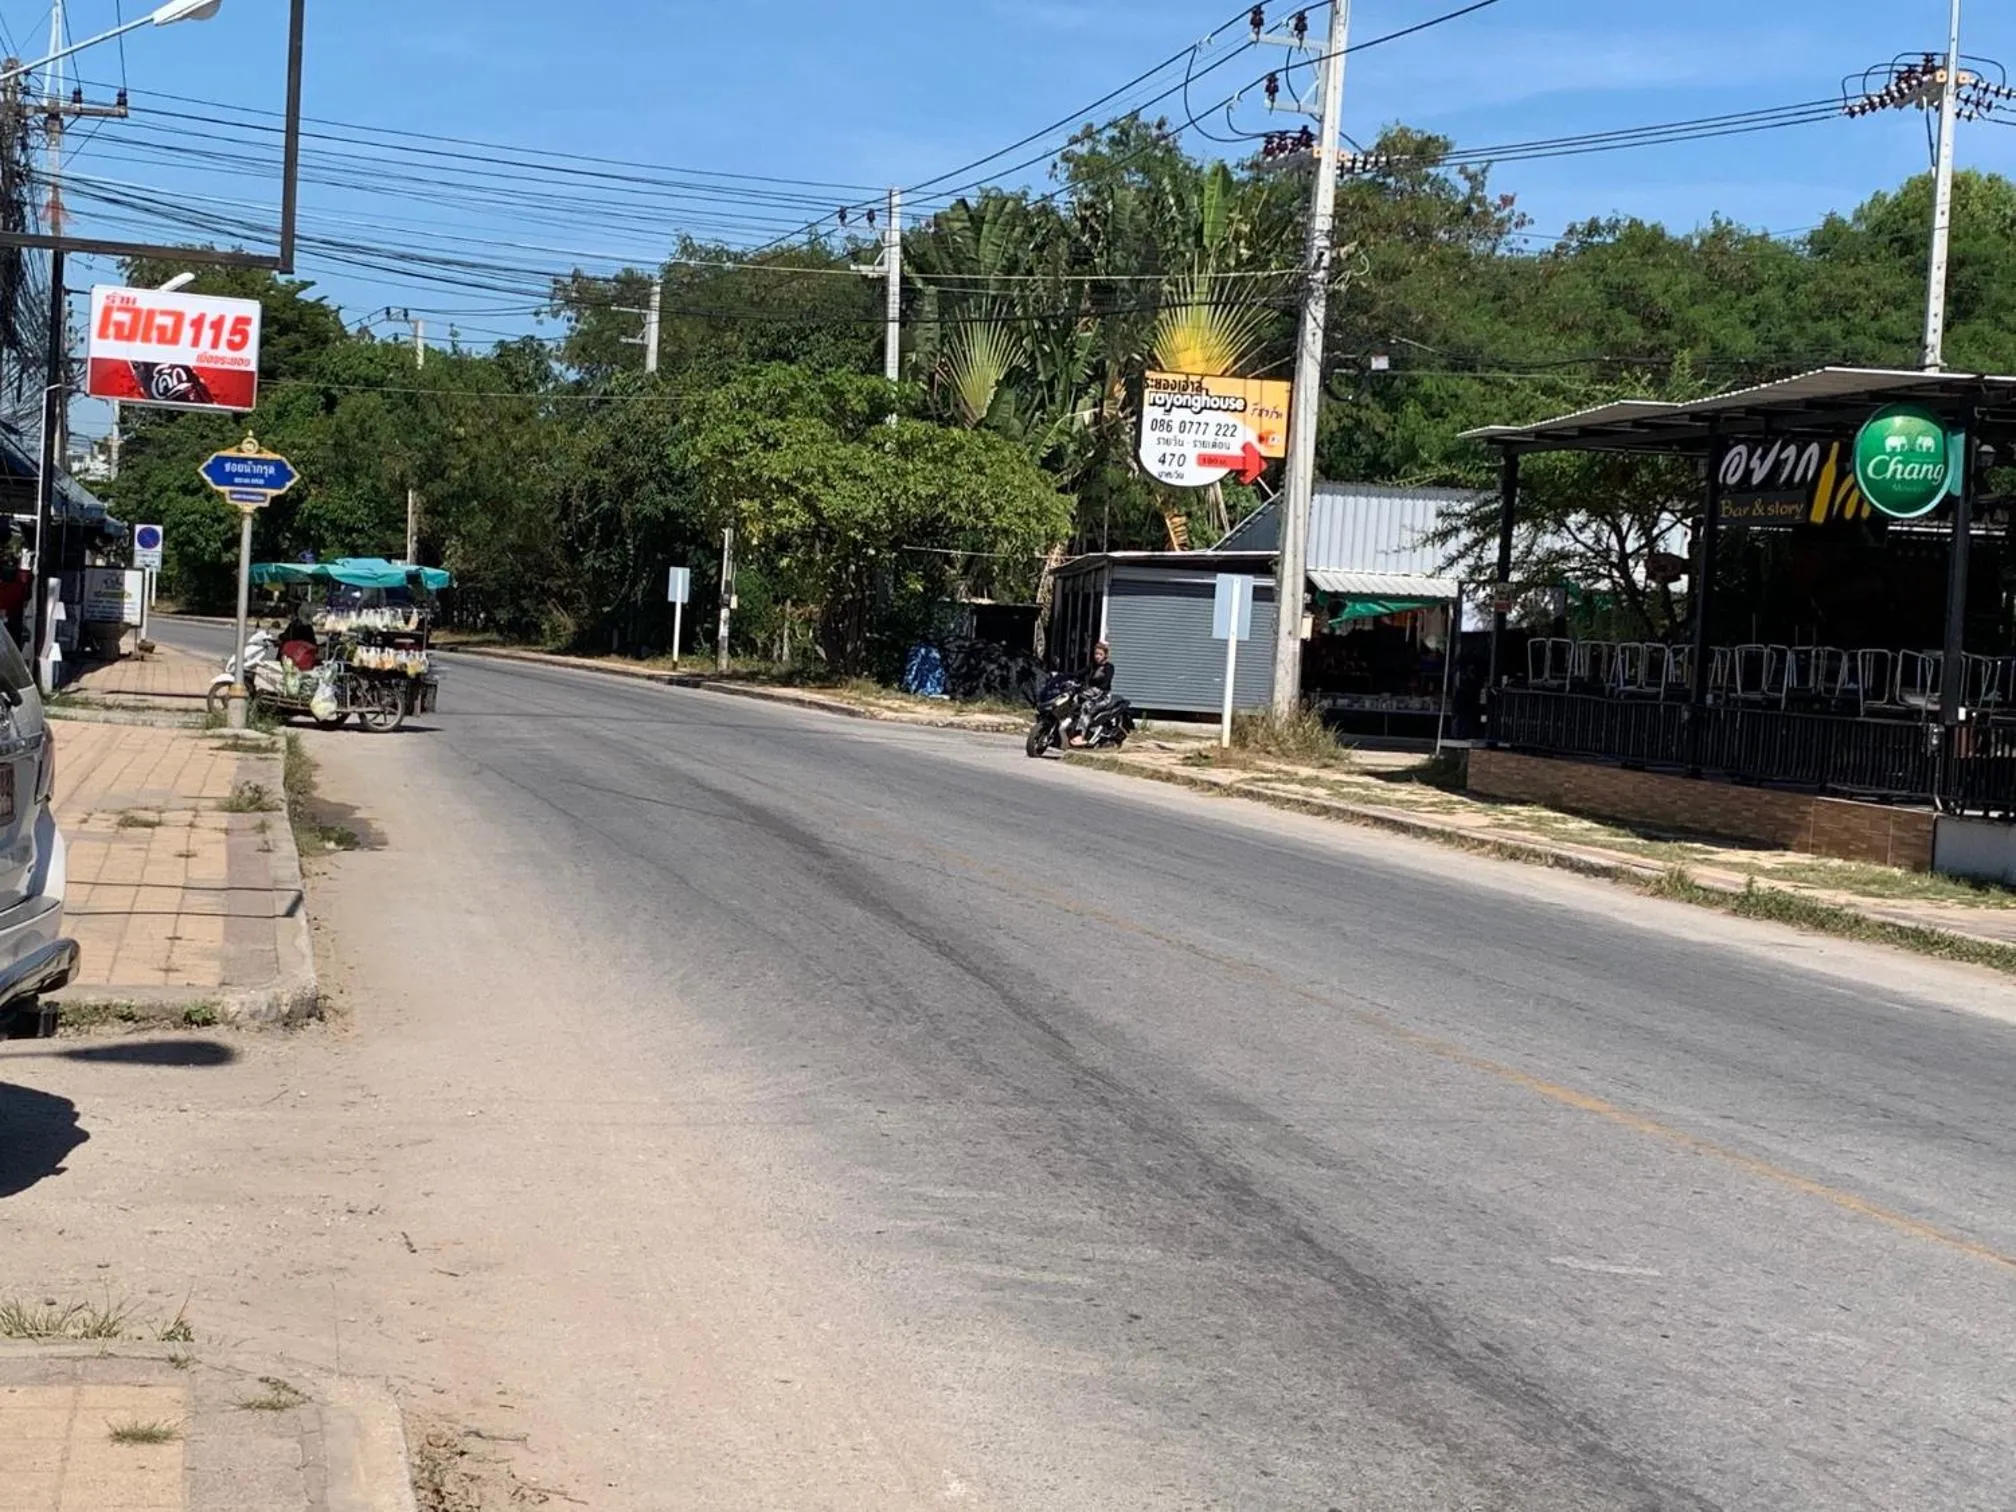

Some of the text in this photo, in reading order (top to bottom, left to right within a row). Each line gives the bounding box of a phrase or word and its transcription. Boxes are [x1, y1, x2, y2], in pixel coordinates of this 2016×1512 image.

[189, 312, 253, 352] 115
[1149, 392, 1245, 413] rayonghouse
[1150, 418, 1238, 438] 086 0777 222
[1158, 452, 1187, 467] 470
[1867, 455, 1945, 486] Chang
[1720, 500, 1749, 517] Bar
[1768, 500, 1804, 519] story
